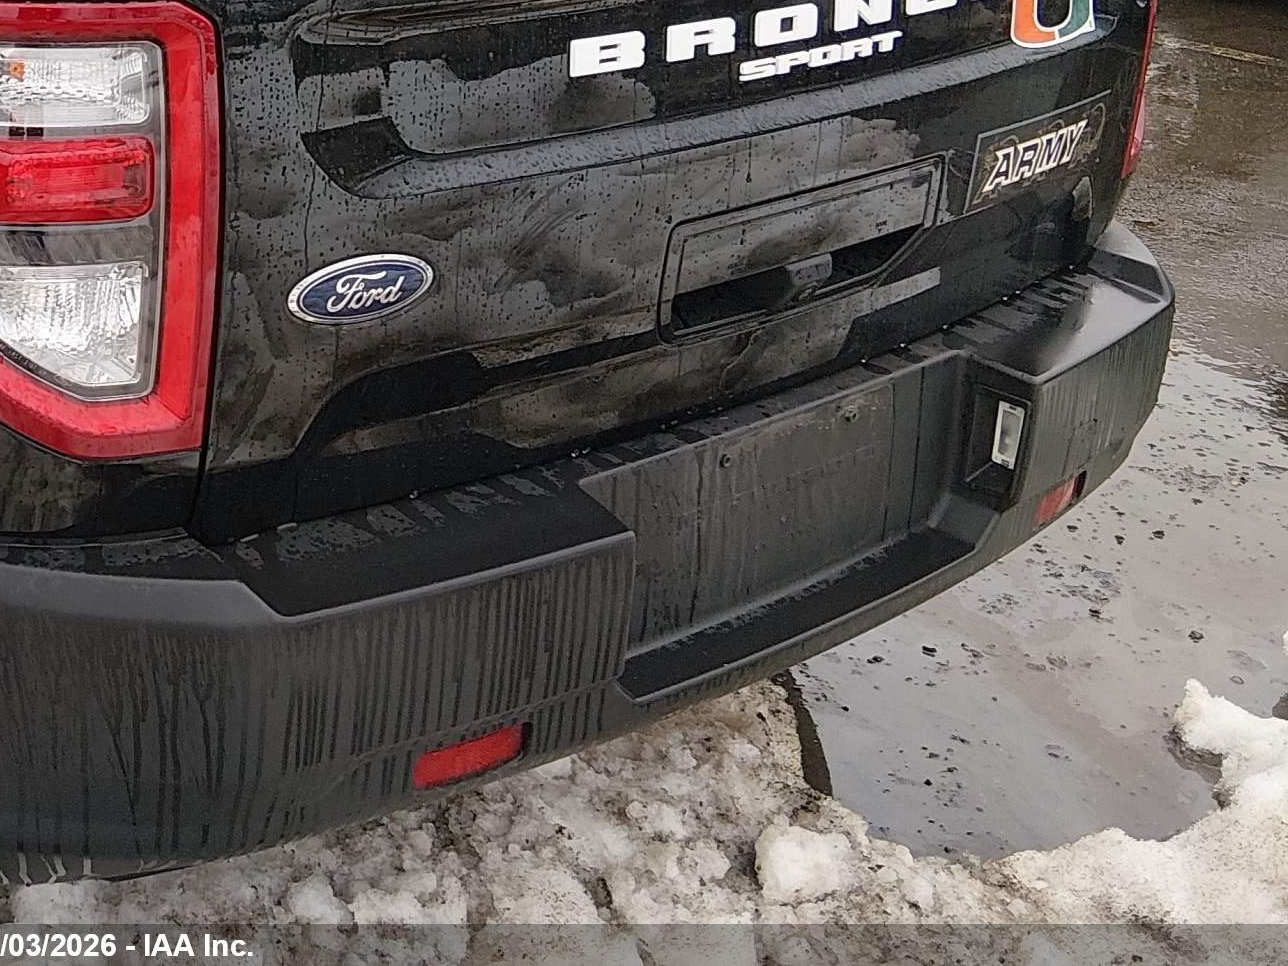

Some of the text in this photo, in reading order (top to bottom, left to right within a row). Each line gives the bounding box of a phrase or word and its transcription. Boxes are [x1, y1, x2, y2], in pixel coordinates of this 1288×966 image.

[738, 30, 903, 82] SPORT
[981, 119, 1089, 193] ARMY
[326, 270, 405, 313] Ford
